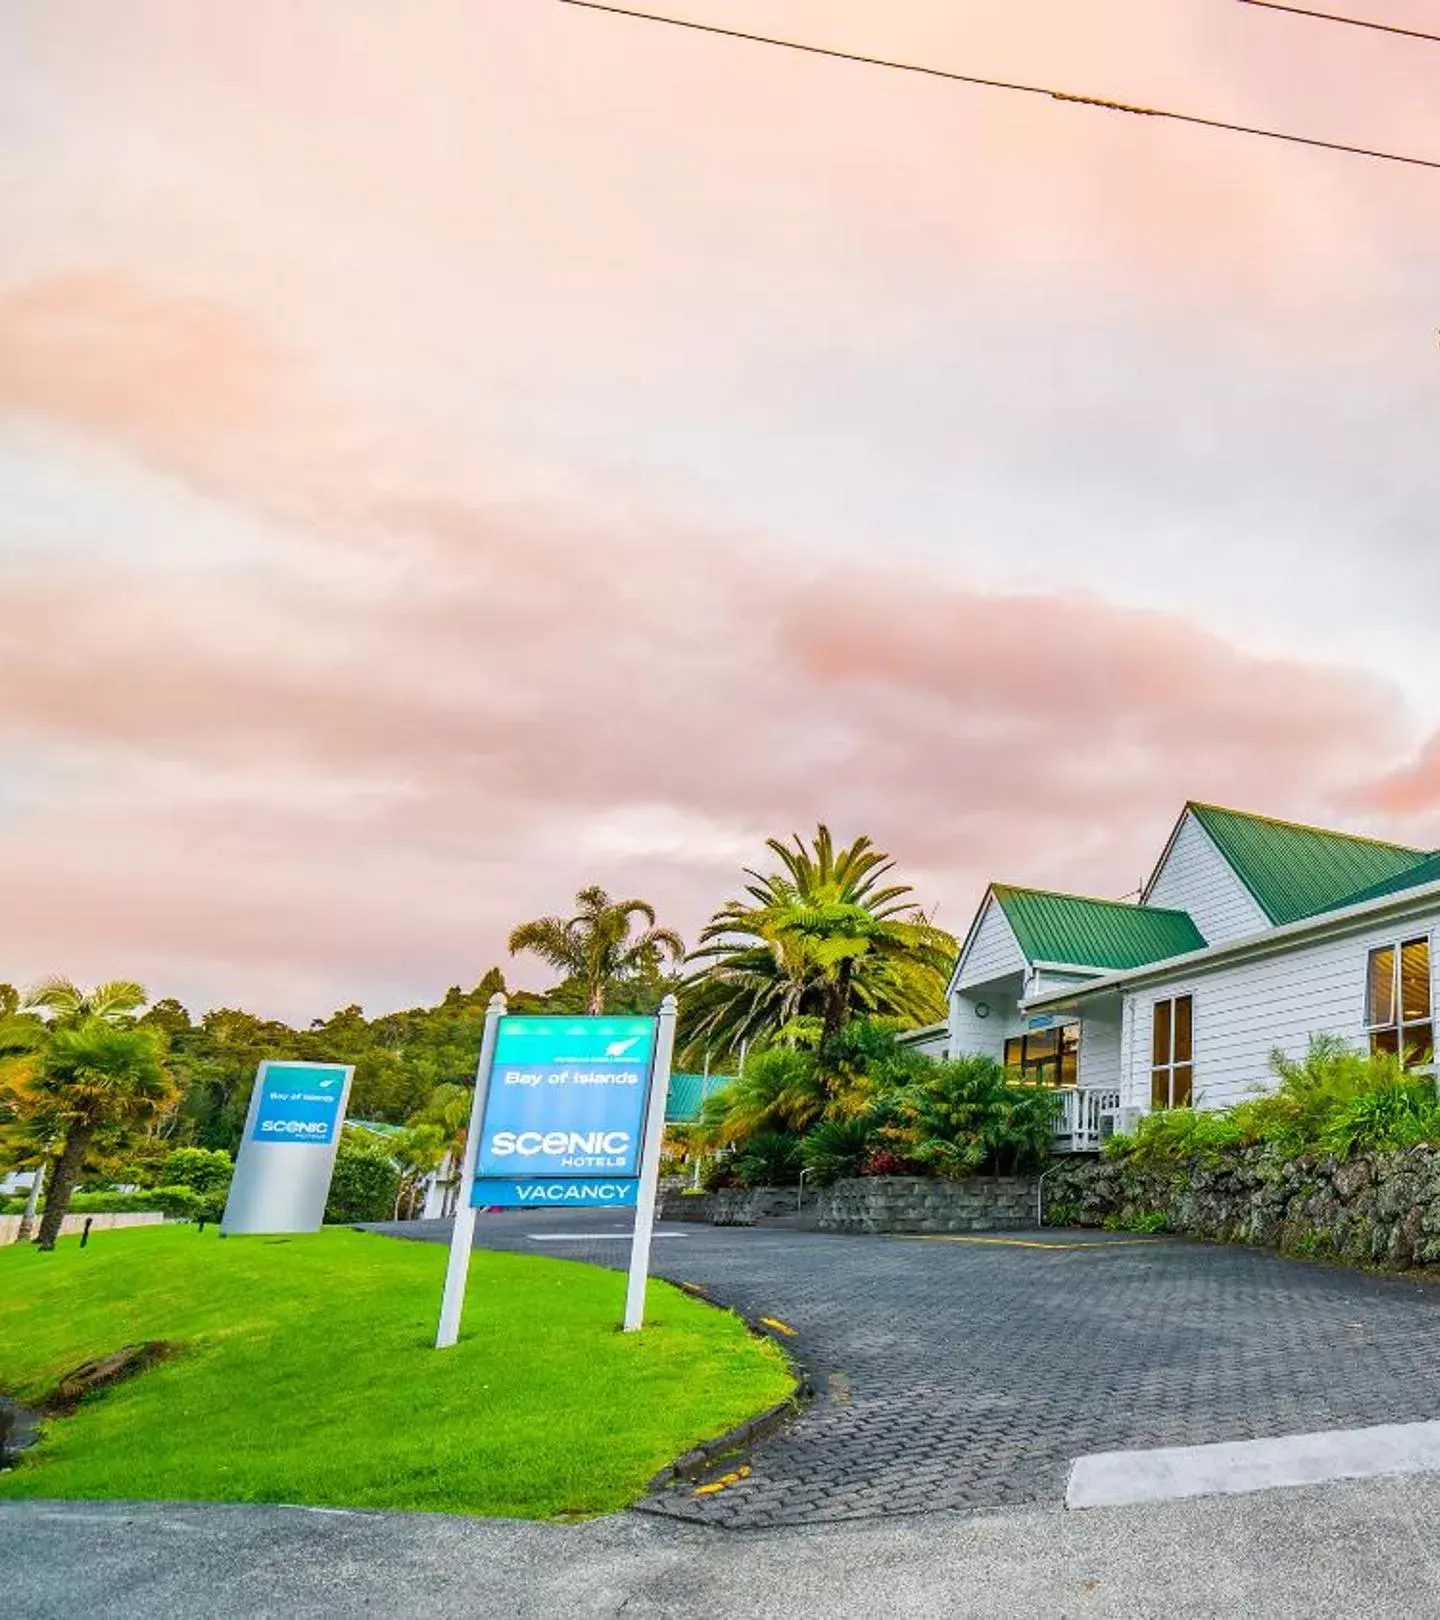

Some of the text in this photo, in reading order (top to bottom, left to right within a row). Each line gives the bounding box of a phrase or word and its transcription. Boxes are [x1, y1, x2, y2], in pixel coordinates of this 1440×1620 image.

[505, 1071, 542, 1087] Bay
[548, 1070, 568, 1085] of
[562, 1156, 627, 1167] HOTELS
[516, 1185, 630, 1200] VACANCY
